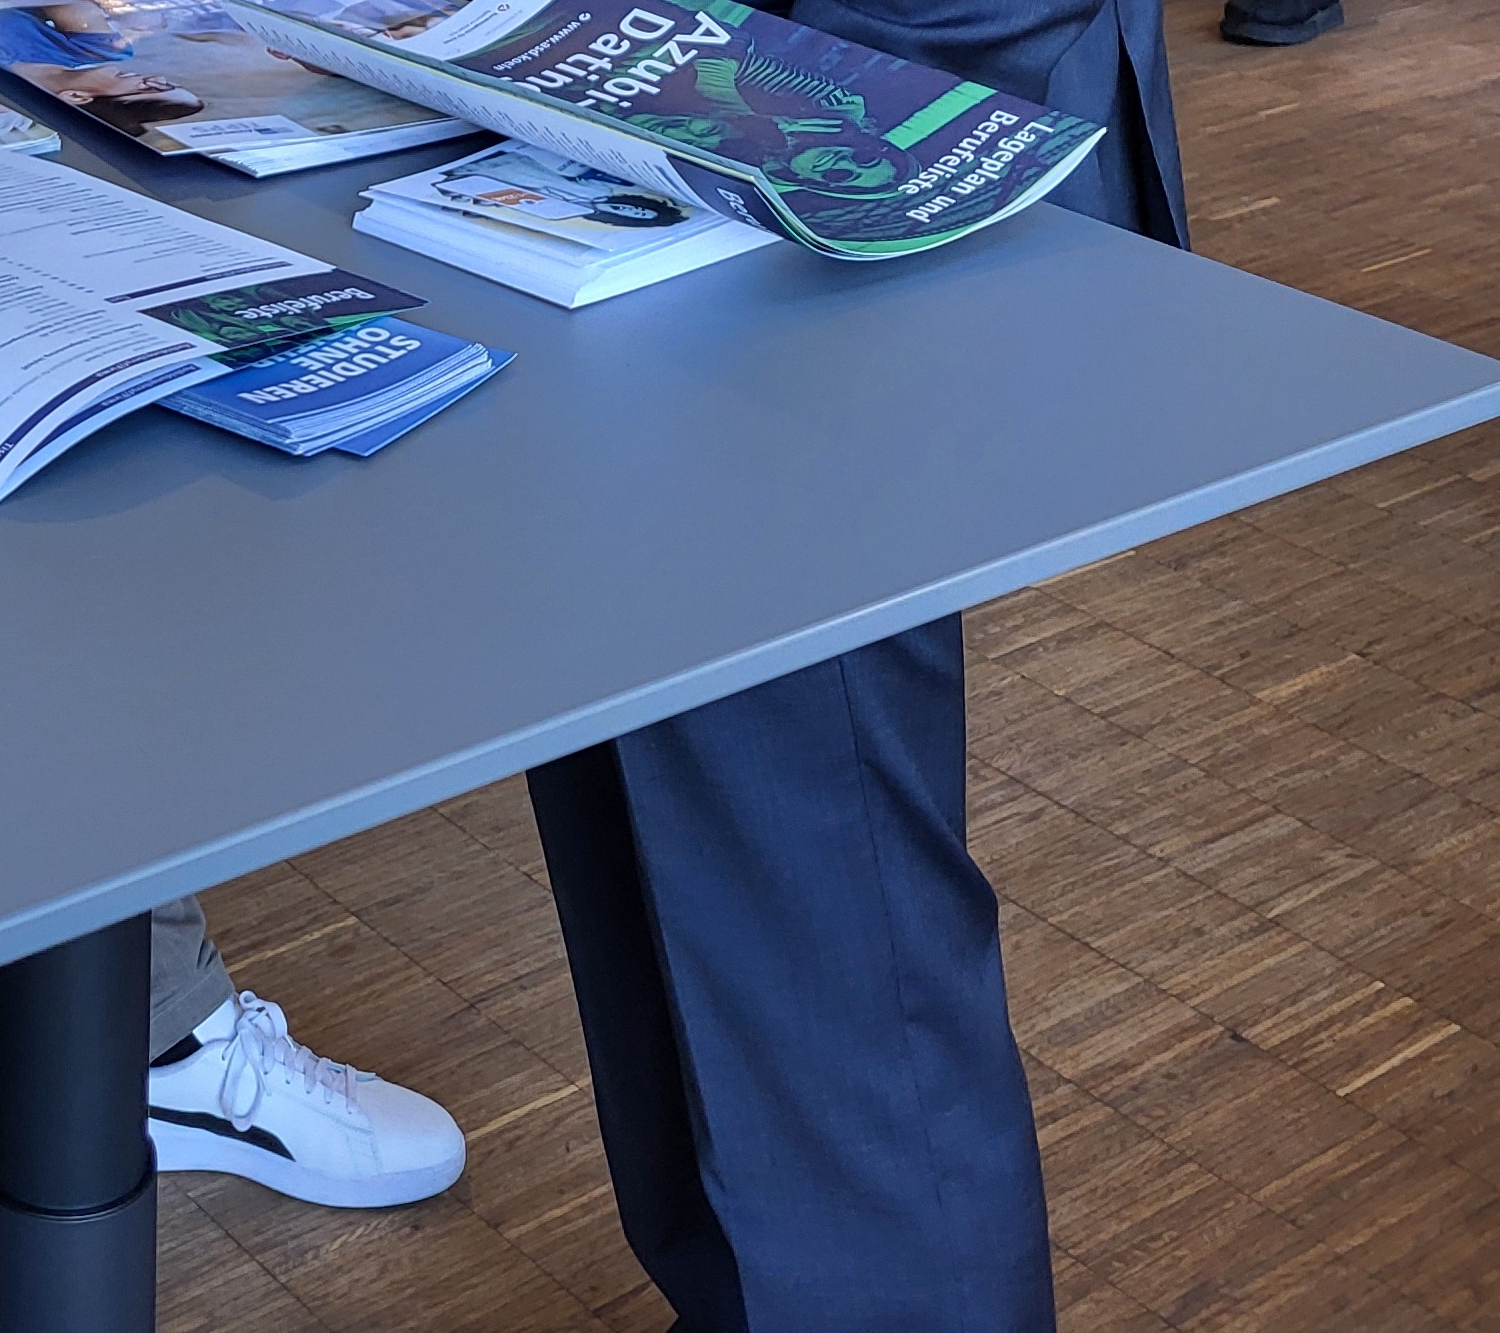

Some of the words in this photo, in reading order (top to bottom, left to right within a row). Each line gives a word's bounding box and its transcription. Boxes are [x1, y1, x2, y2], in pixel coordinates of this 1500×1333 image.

[493, 20, 581, 71] www.asd.koeln
[898, 110, 1020, 195] Berufeliste
[951, 122, 1054, 194] Lageplan
[906, 195, 957, 223] und
[234, 287, 376, 320] Berufeliste
[237, 334, 421, 405] STUDIEREN
[290, 327, 391, 371] OHNE
